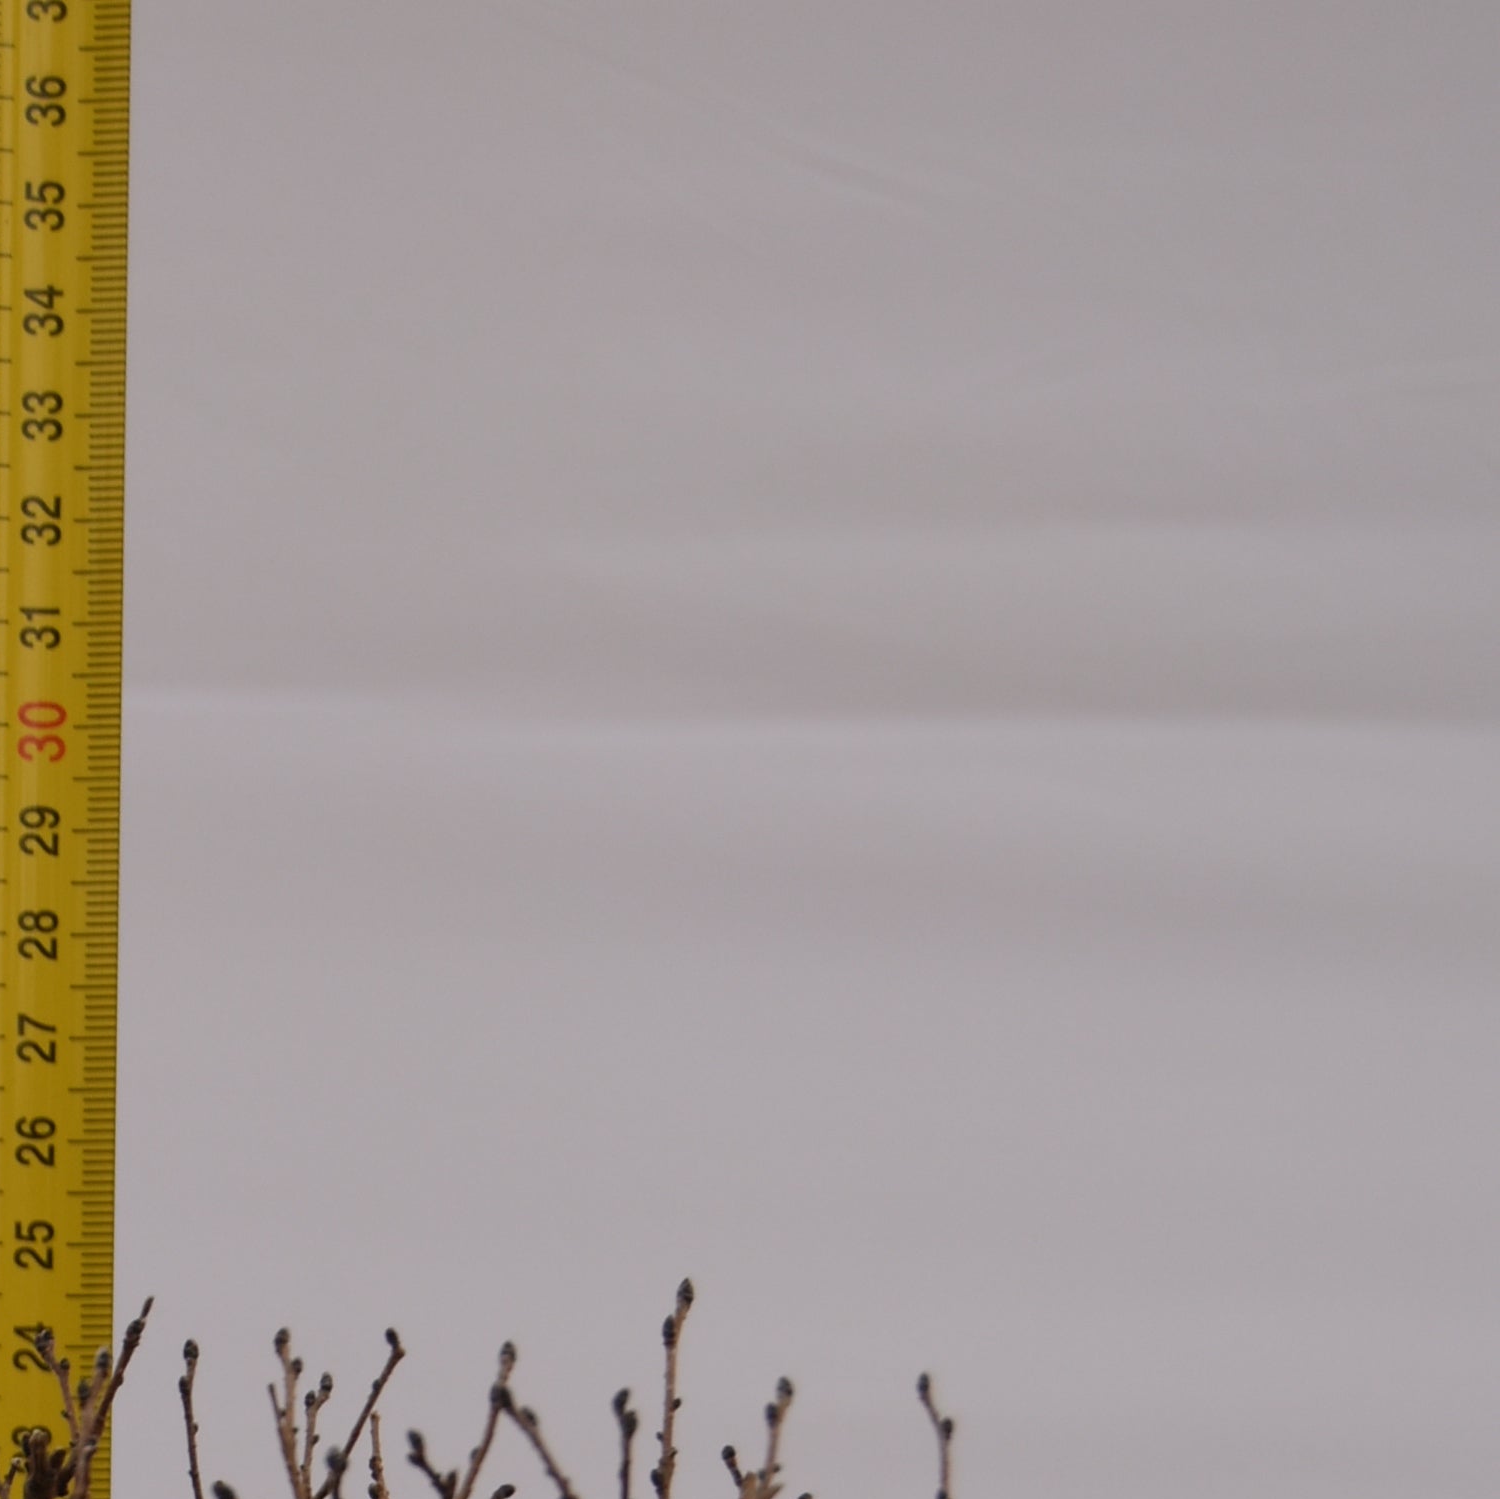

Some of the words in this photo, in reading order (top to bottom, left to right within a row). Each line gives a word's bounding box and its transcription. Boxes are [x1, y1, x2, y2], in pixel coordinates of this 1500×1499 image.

[25, 75, 67, 127] 36
[24, 181, 66, 231] 35
[23, 285, 64, 336] 34
[22, 390, 63, 442] 33
[21, 496, 61, 546] 32
[20, 607, 61, 650] 31
[17, 701, 67, 762] 30
[19, 805, 60, 856] 29
[18, 910, 58, 961] 28
[17, 1014, 56, 1063] 27
[15, 1116, 56, 1167] 26
[14, 1220, 55, 1270] 25
